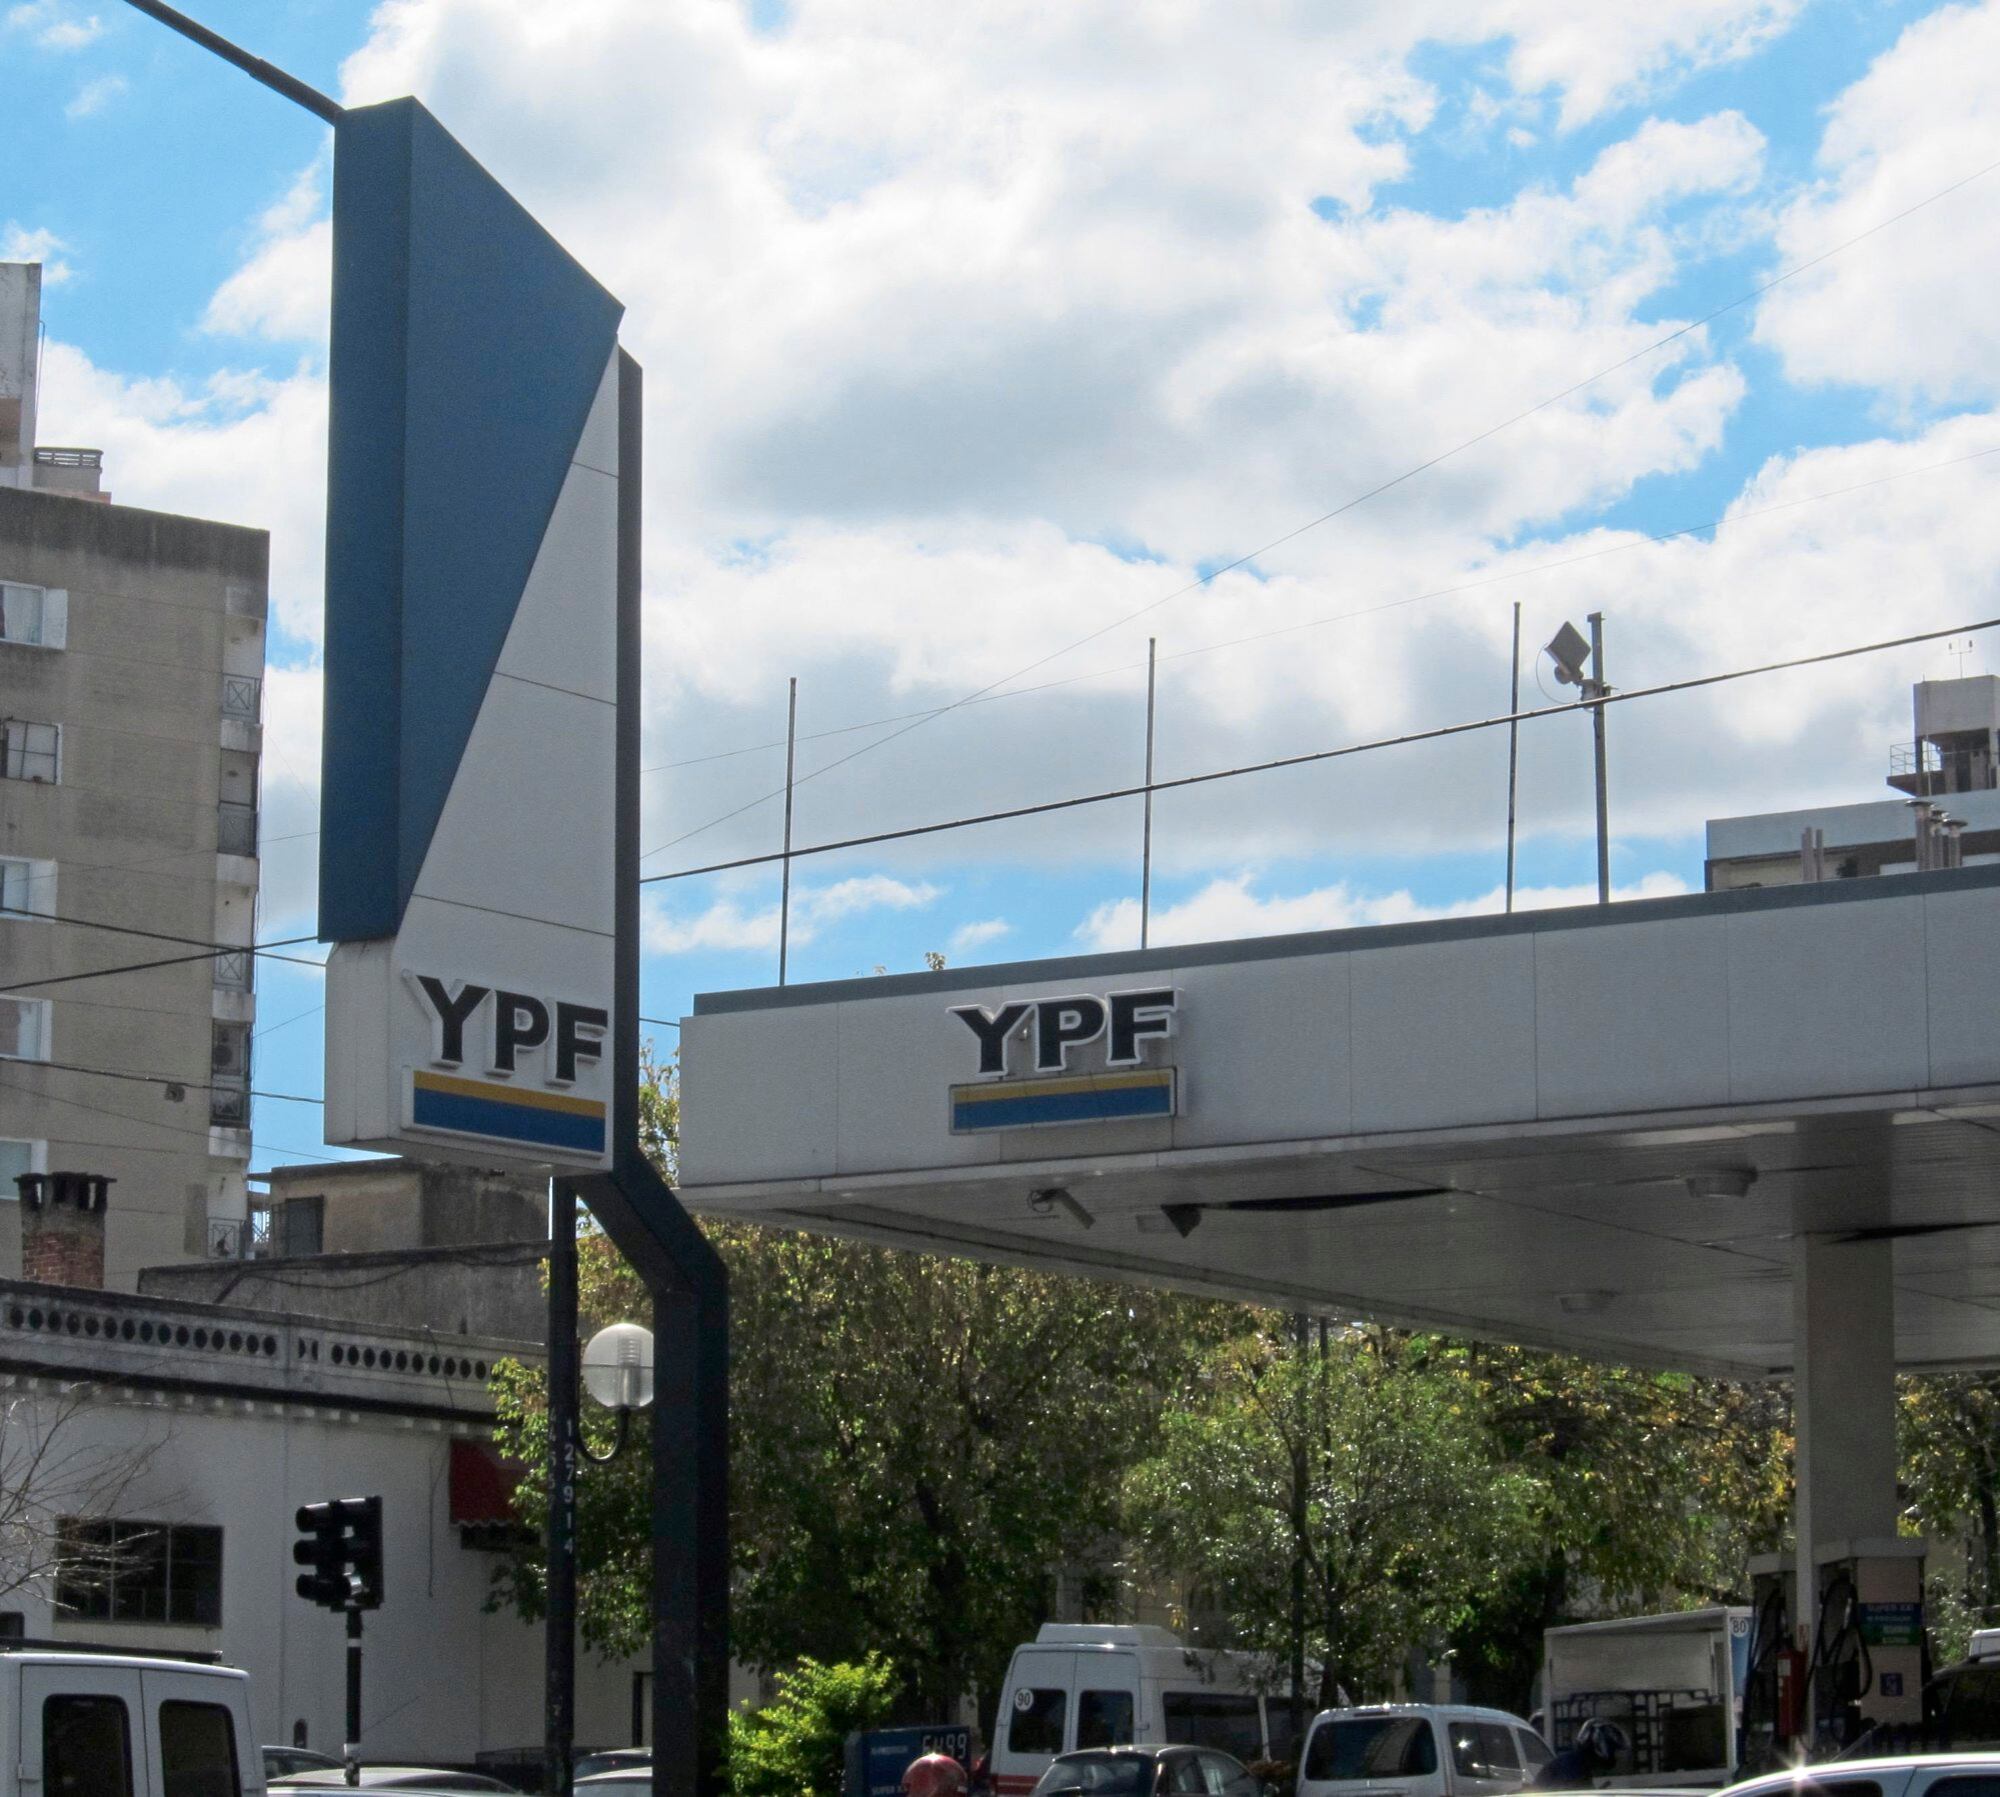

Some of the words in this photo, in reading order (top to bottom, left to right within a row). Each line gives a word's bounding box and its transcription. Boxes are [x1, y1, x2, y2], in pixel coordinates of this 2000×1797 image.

[413, 973, 609, 1085] YPF
[949, 988, 1177, 1075] YPF
[562, 1417, 575, 1555] 127914
[1732, 1619, 1746, 1633] 80
[1017, 1691, 1031, 1707] 90
